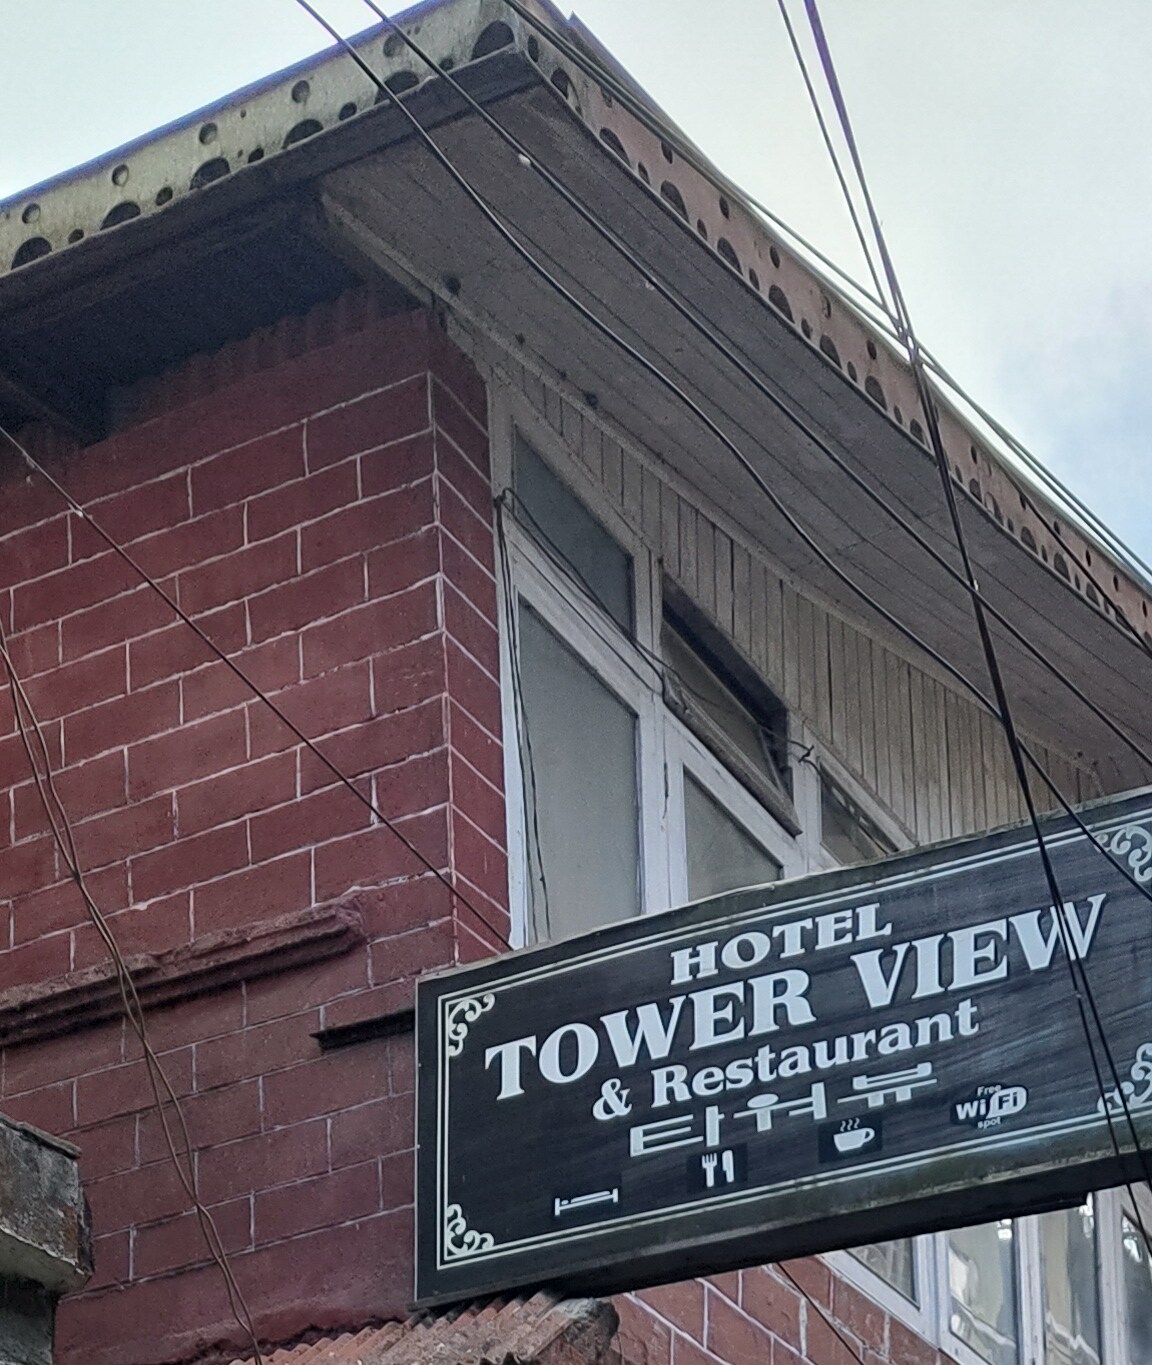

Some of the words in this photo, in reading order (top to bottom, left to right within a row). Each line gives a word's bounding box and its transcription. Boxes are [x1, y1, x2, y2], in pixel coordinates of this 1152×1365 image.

[670, 902, 893, 985] HOTEL
[484, 968, 817, 1101] TOWER
[850, 893, 1107, 1010] VIEW
[592, 1078, 632, 1121] &
[651, 999, 980, 1108] Restaurant
[976, 1084, 1002, 1097] Free
[629, 1062, 939, 1158] 타워뷰
[977, 1116, 1002, 1129] spot
